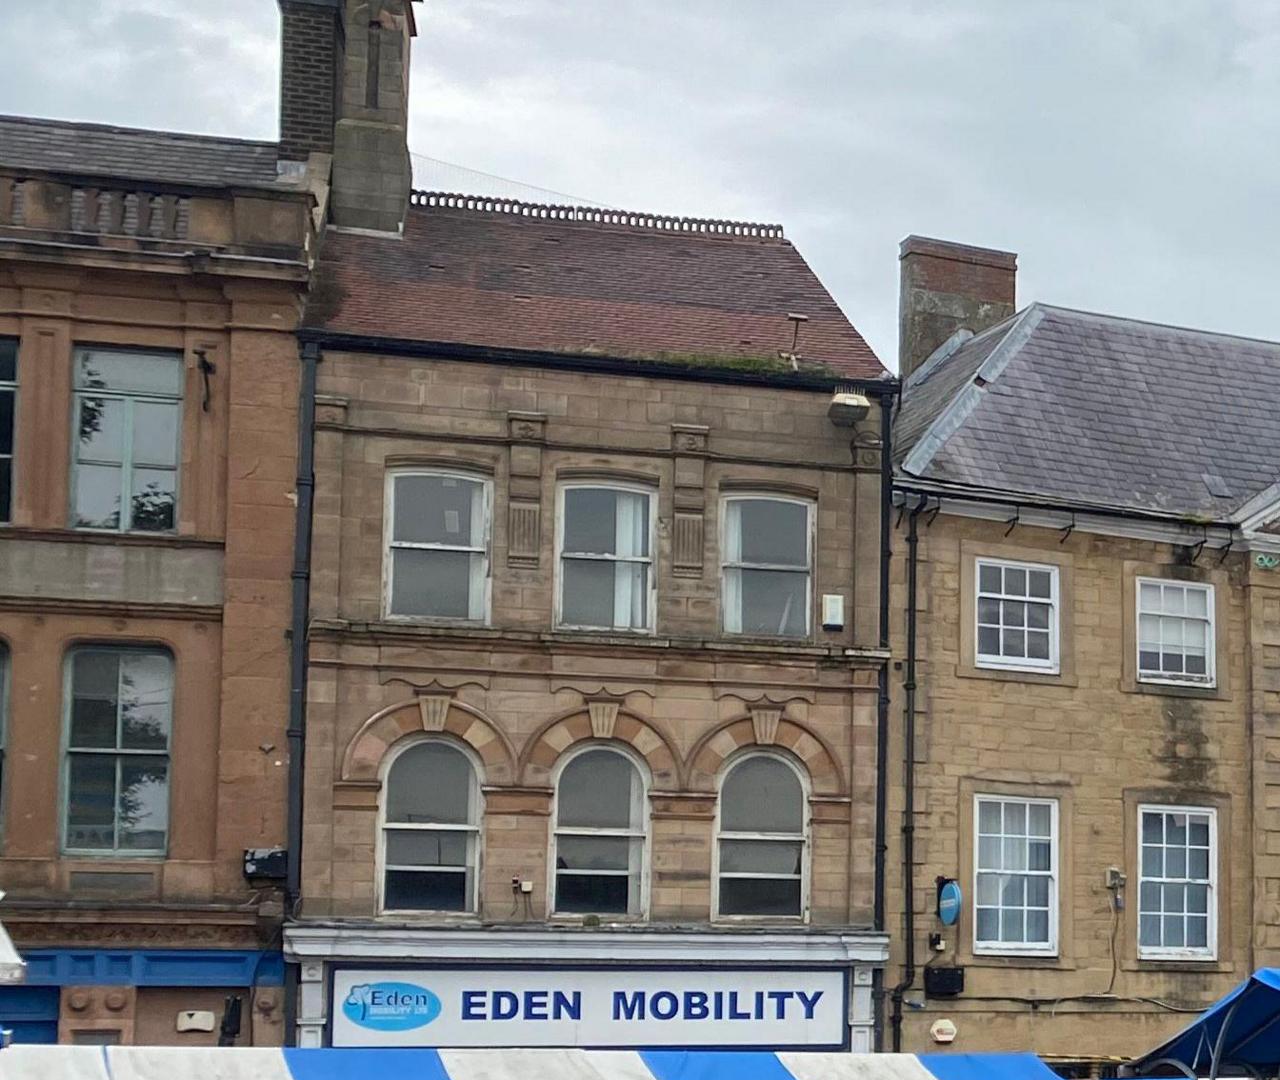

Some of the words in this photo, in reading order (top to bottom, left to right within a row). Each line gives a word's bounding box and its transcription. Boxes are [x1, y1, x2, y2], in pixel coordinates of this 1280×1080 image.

[370, 990, 428, 1006] Eden
[461, 991, 582, 1021] EDEN
[612, 991, 824, 1021] MOBILITY
